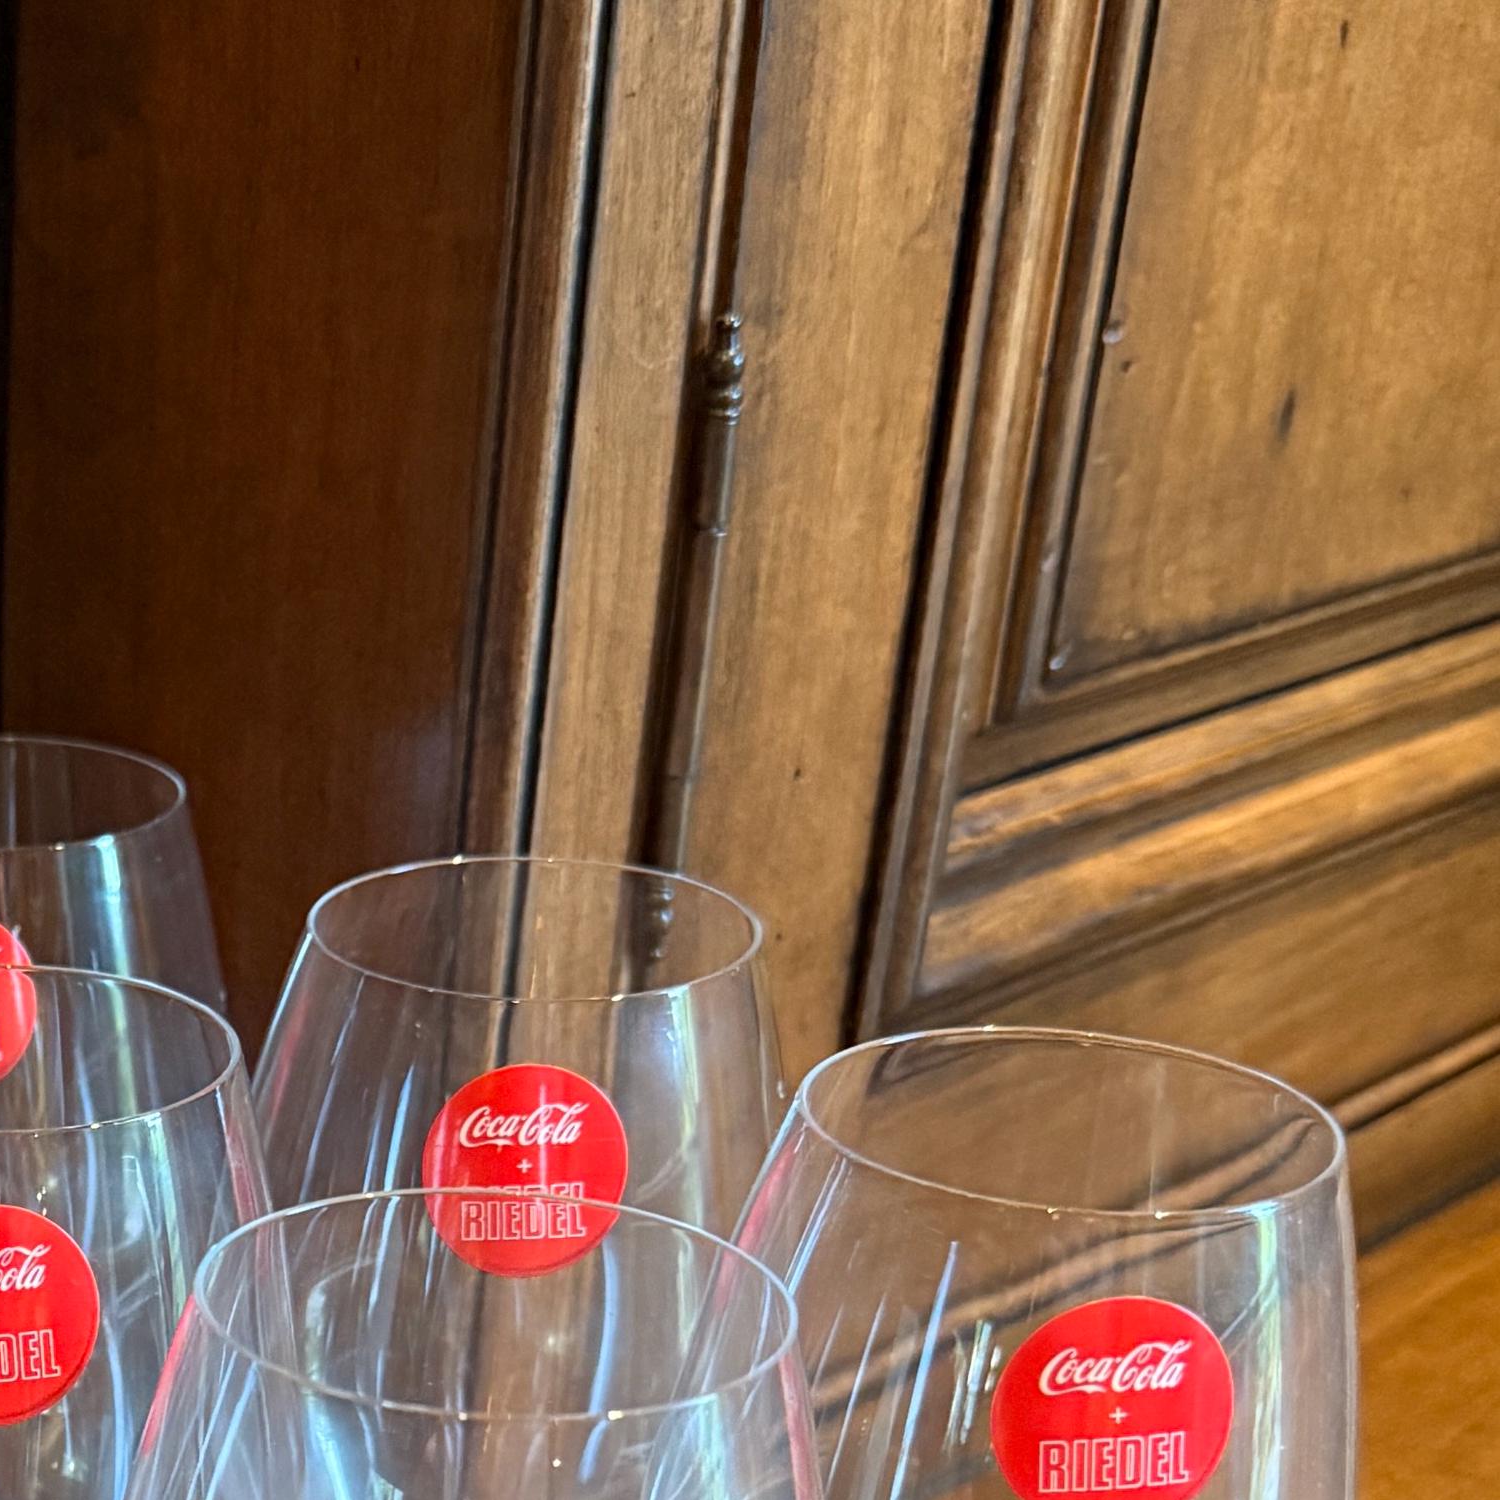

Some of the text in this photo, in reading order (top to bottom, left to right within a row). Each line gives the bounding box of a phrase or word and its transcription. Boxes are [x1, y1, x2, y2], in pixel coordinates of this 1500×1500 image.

[459, 1102, 590, 1148] Coca-Cola
[461, 1200, 587, 1241] RIEDEL
[1038, 1339, 1192, 1396] Coca-Cola
[1038, 1431, 1189, 1493] RIEDEL
